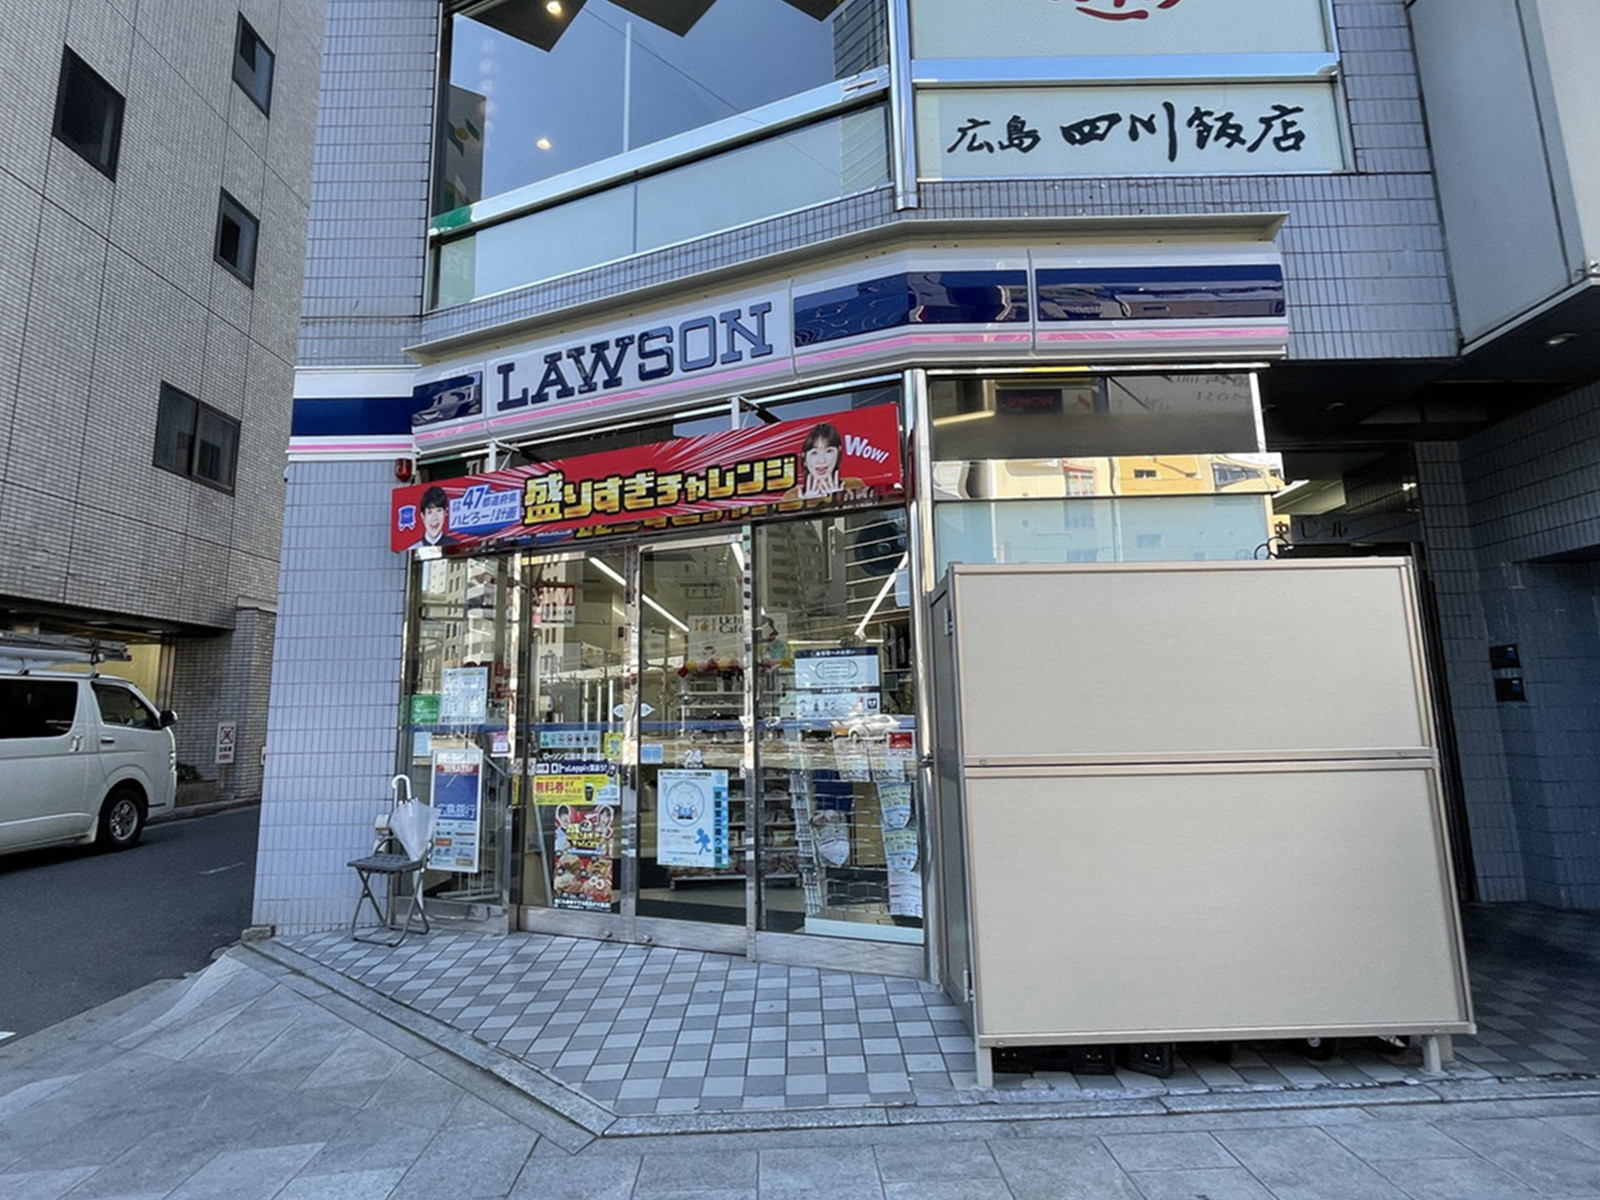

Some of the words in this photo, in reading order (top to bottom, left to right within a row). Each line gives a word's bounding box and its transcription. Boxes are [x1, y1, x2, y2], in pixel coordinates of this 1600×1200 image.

[947, 115, 1042, 153] 広島
[1060, 101, 1306, 162] 四川飯店
[497, 301, 774, 411] LAWSON
[844, 434, 890, 464] Wow!
[524, 456, 796, 524] 盛りすぎチャレンジ
